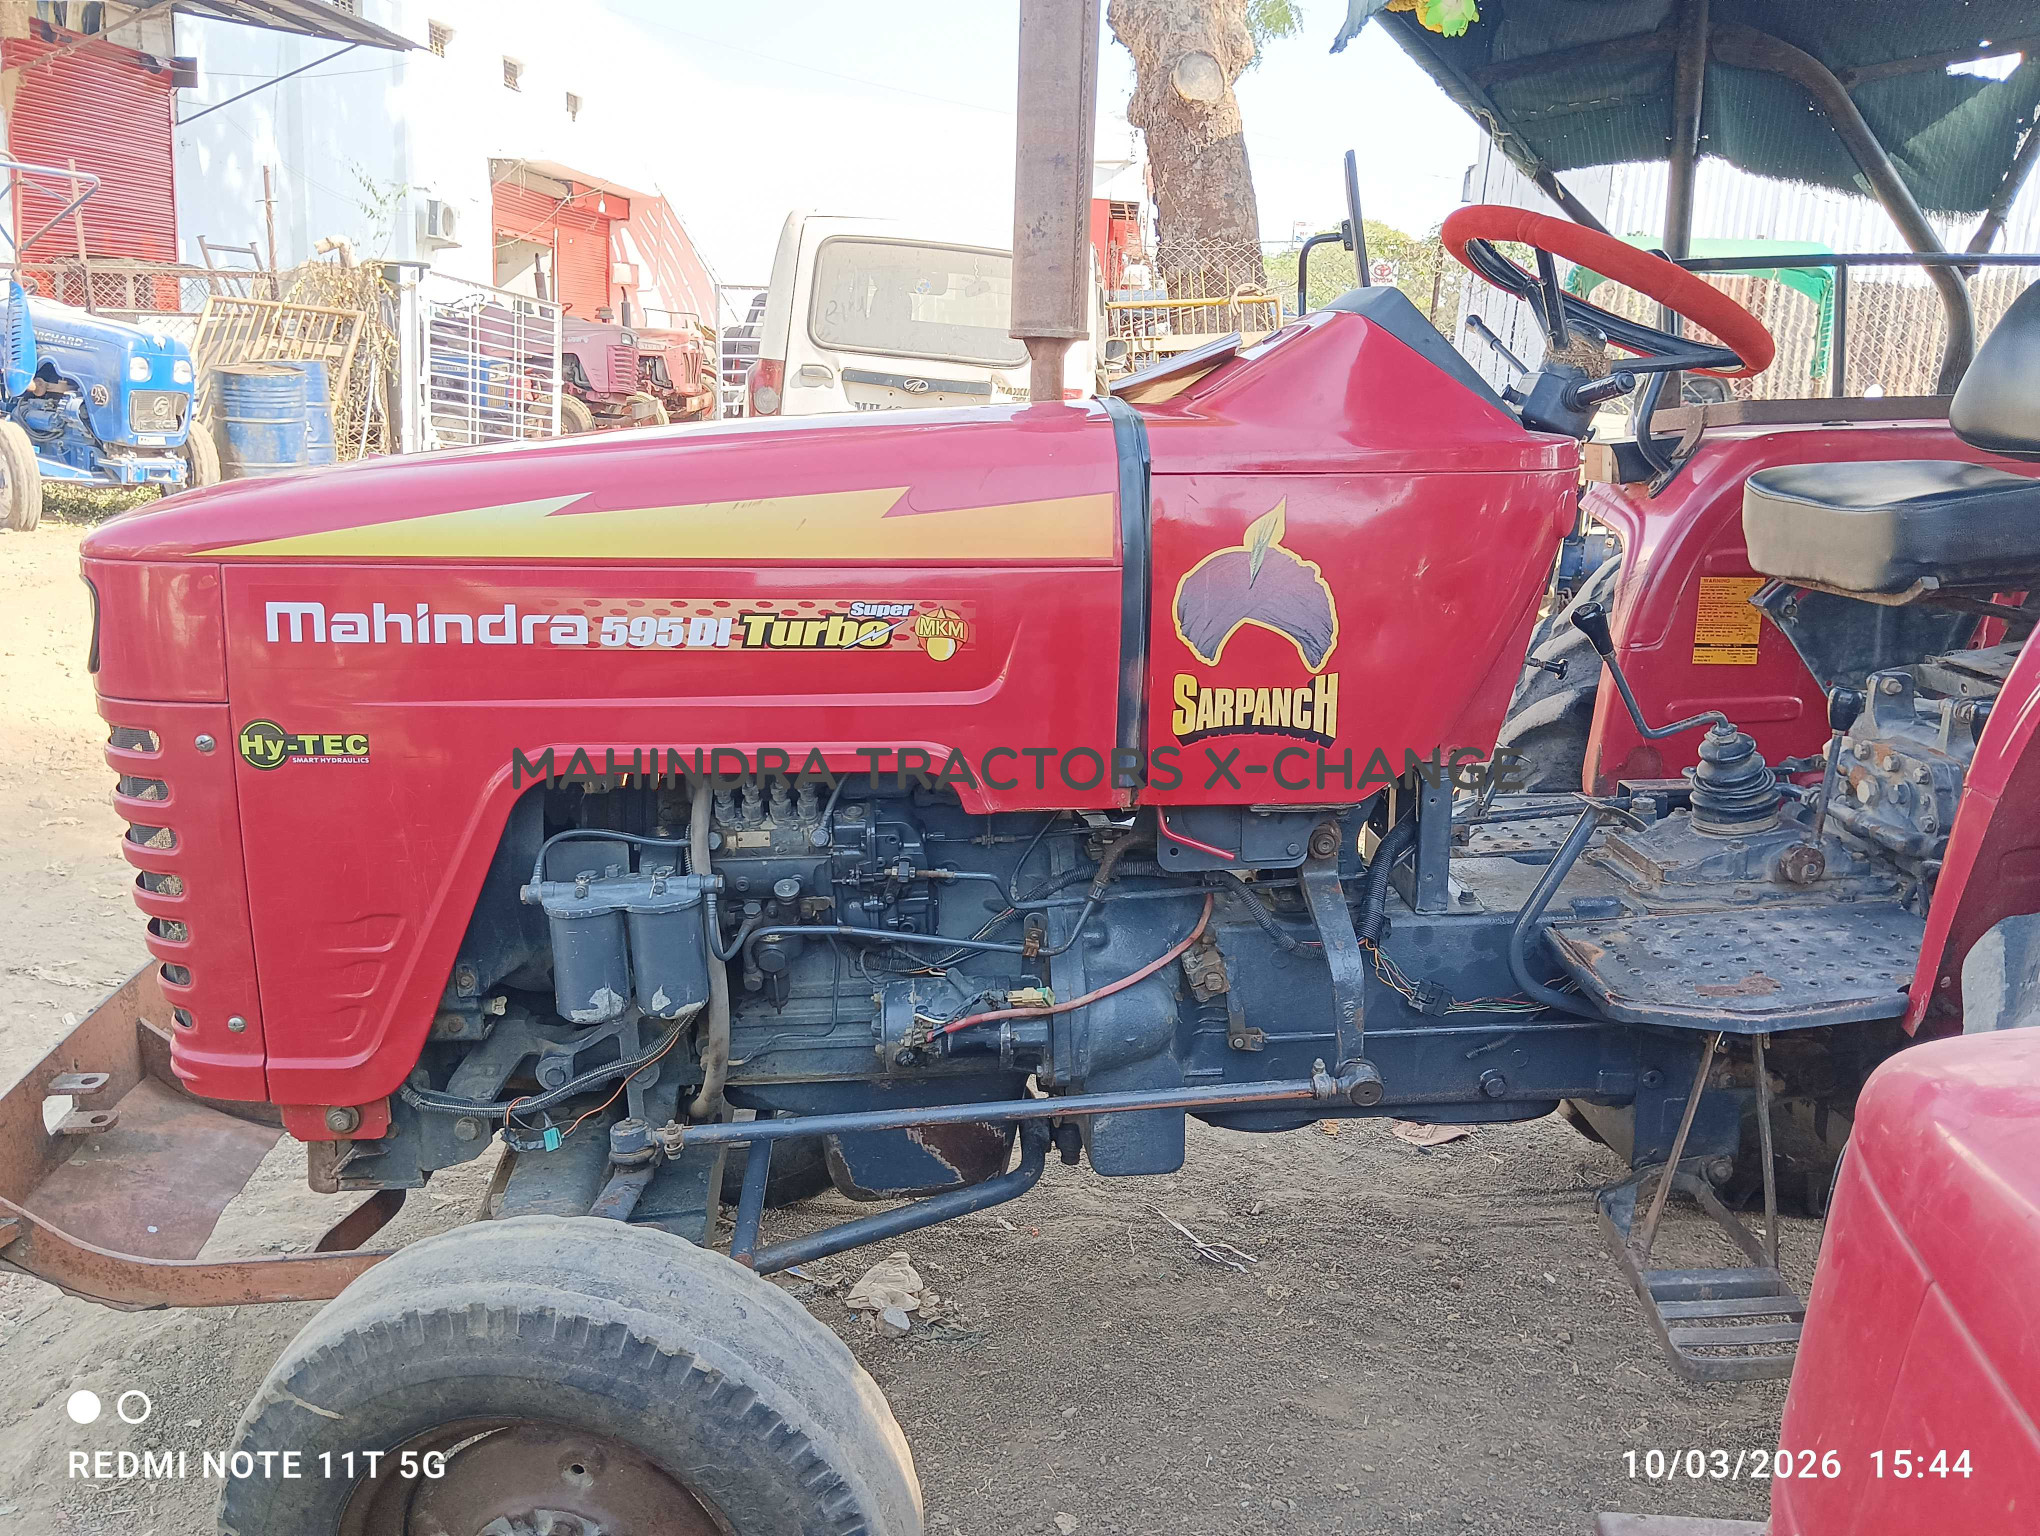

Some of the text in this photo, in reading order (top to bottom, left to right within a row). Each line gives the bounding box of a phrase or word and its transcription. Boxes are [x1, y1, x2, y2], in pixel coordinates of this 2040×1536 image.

[35, 329, 84, 347] RCHARD
[850, 601, 914, 619] Super
[265, 601, 893, 649] Mahindra 595 DI Turbo
[918, 616, 965, 639] MKM
[1171, 671, 1340, 741] SARPANCH
[240, 734, 369, 761] Hy-TEC
